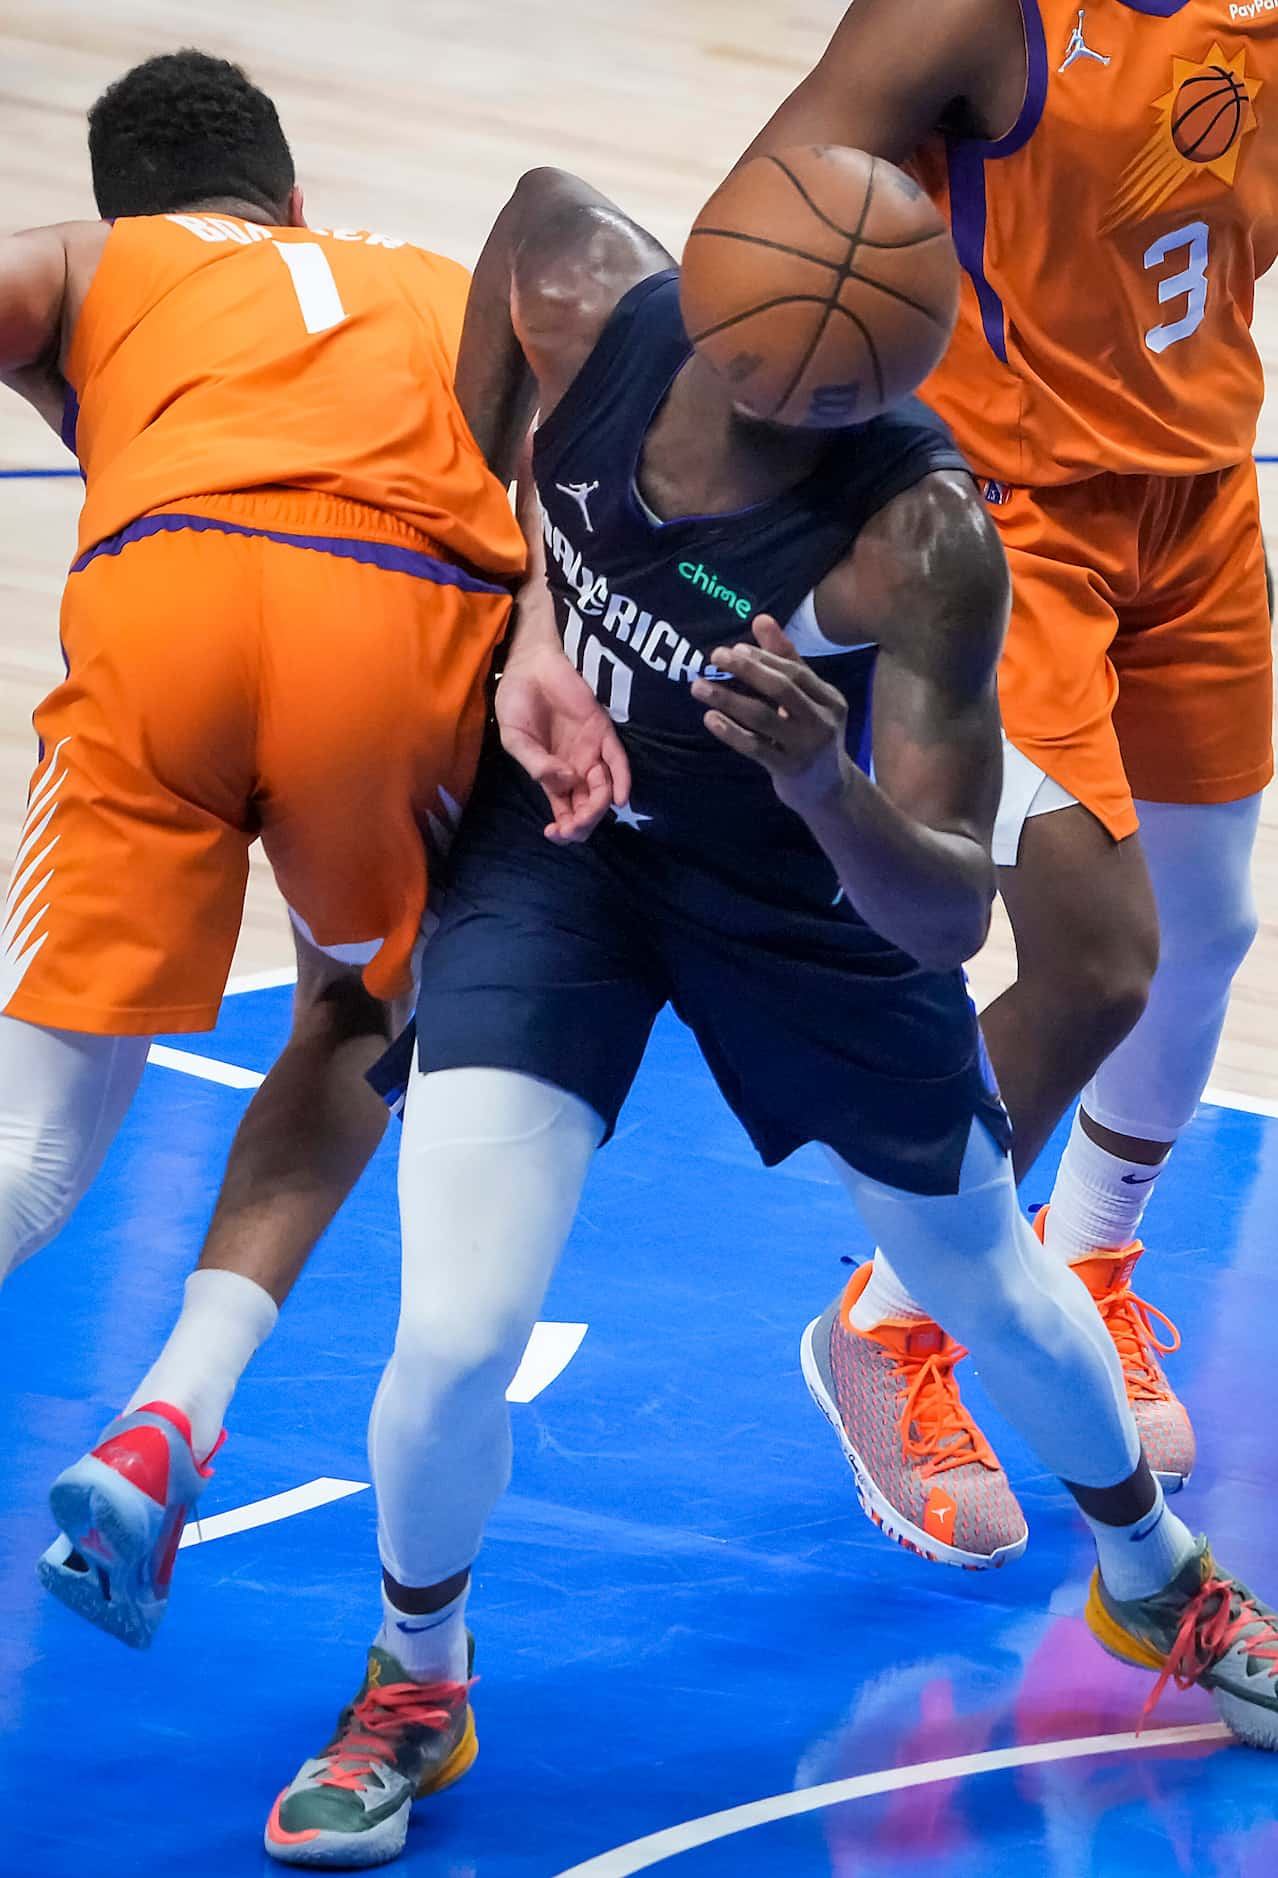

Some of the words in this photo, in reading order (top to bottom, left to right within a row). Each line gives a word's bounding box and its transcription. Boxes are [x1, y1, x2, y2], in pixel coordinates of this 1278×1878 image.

[271, 239, 349, 334] 1
[1143, 221, 1209, 354] 3
[678, 561, 752, 620] chime
[563, 597, 634, 723] 10
